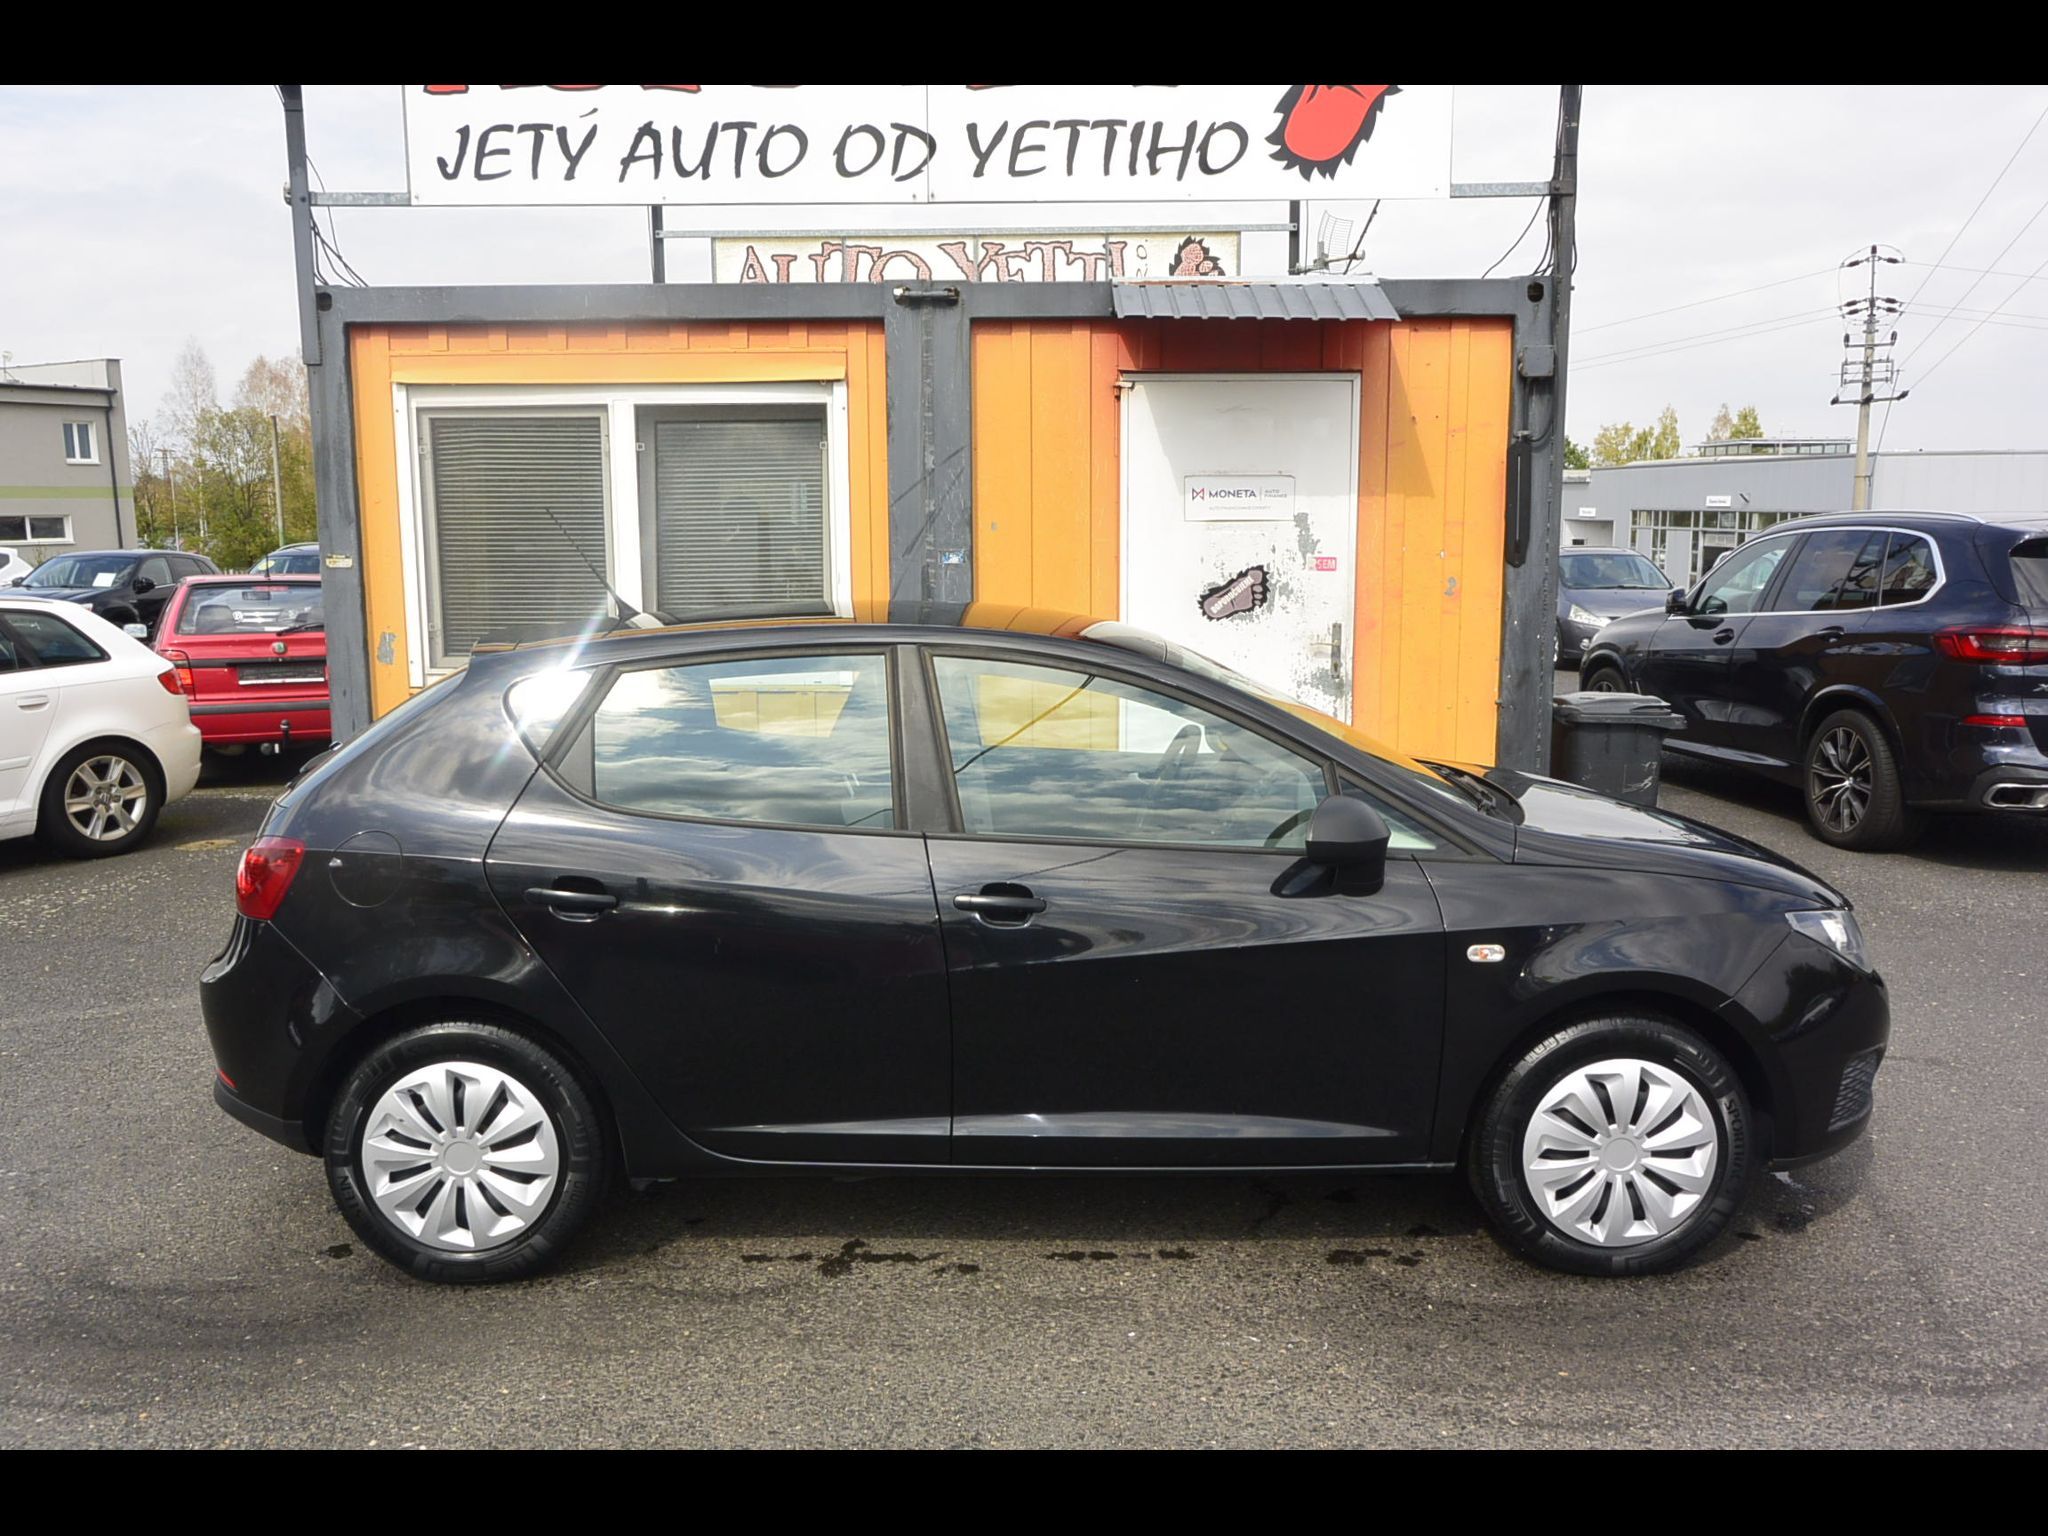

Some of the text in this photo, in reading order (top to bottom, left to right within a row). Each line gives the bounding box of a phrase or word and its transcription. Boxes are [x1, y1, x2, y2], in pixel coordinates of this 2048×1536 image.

[437, 108, 1250, 183] JETÝ AUTO OD YETTIHO
[739, 241, 933, 284] AUTO
[937, 240, 1127, 283] YETTI
[1208, 489, 1257, 499] MONETA
